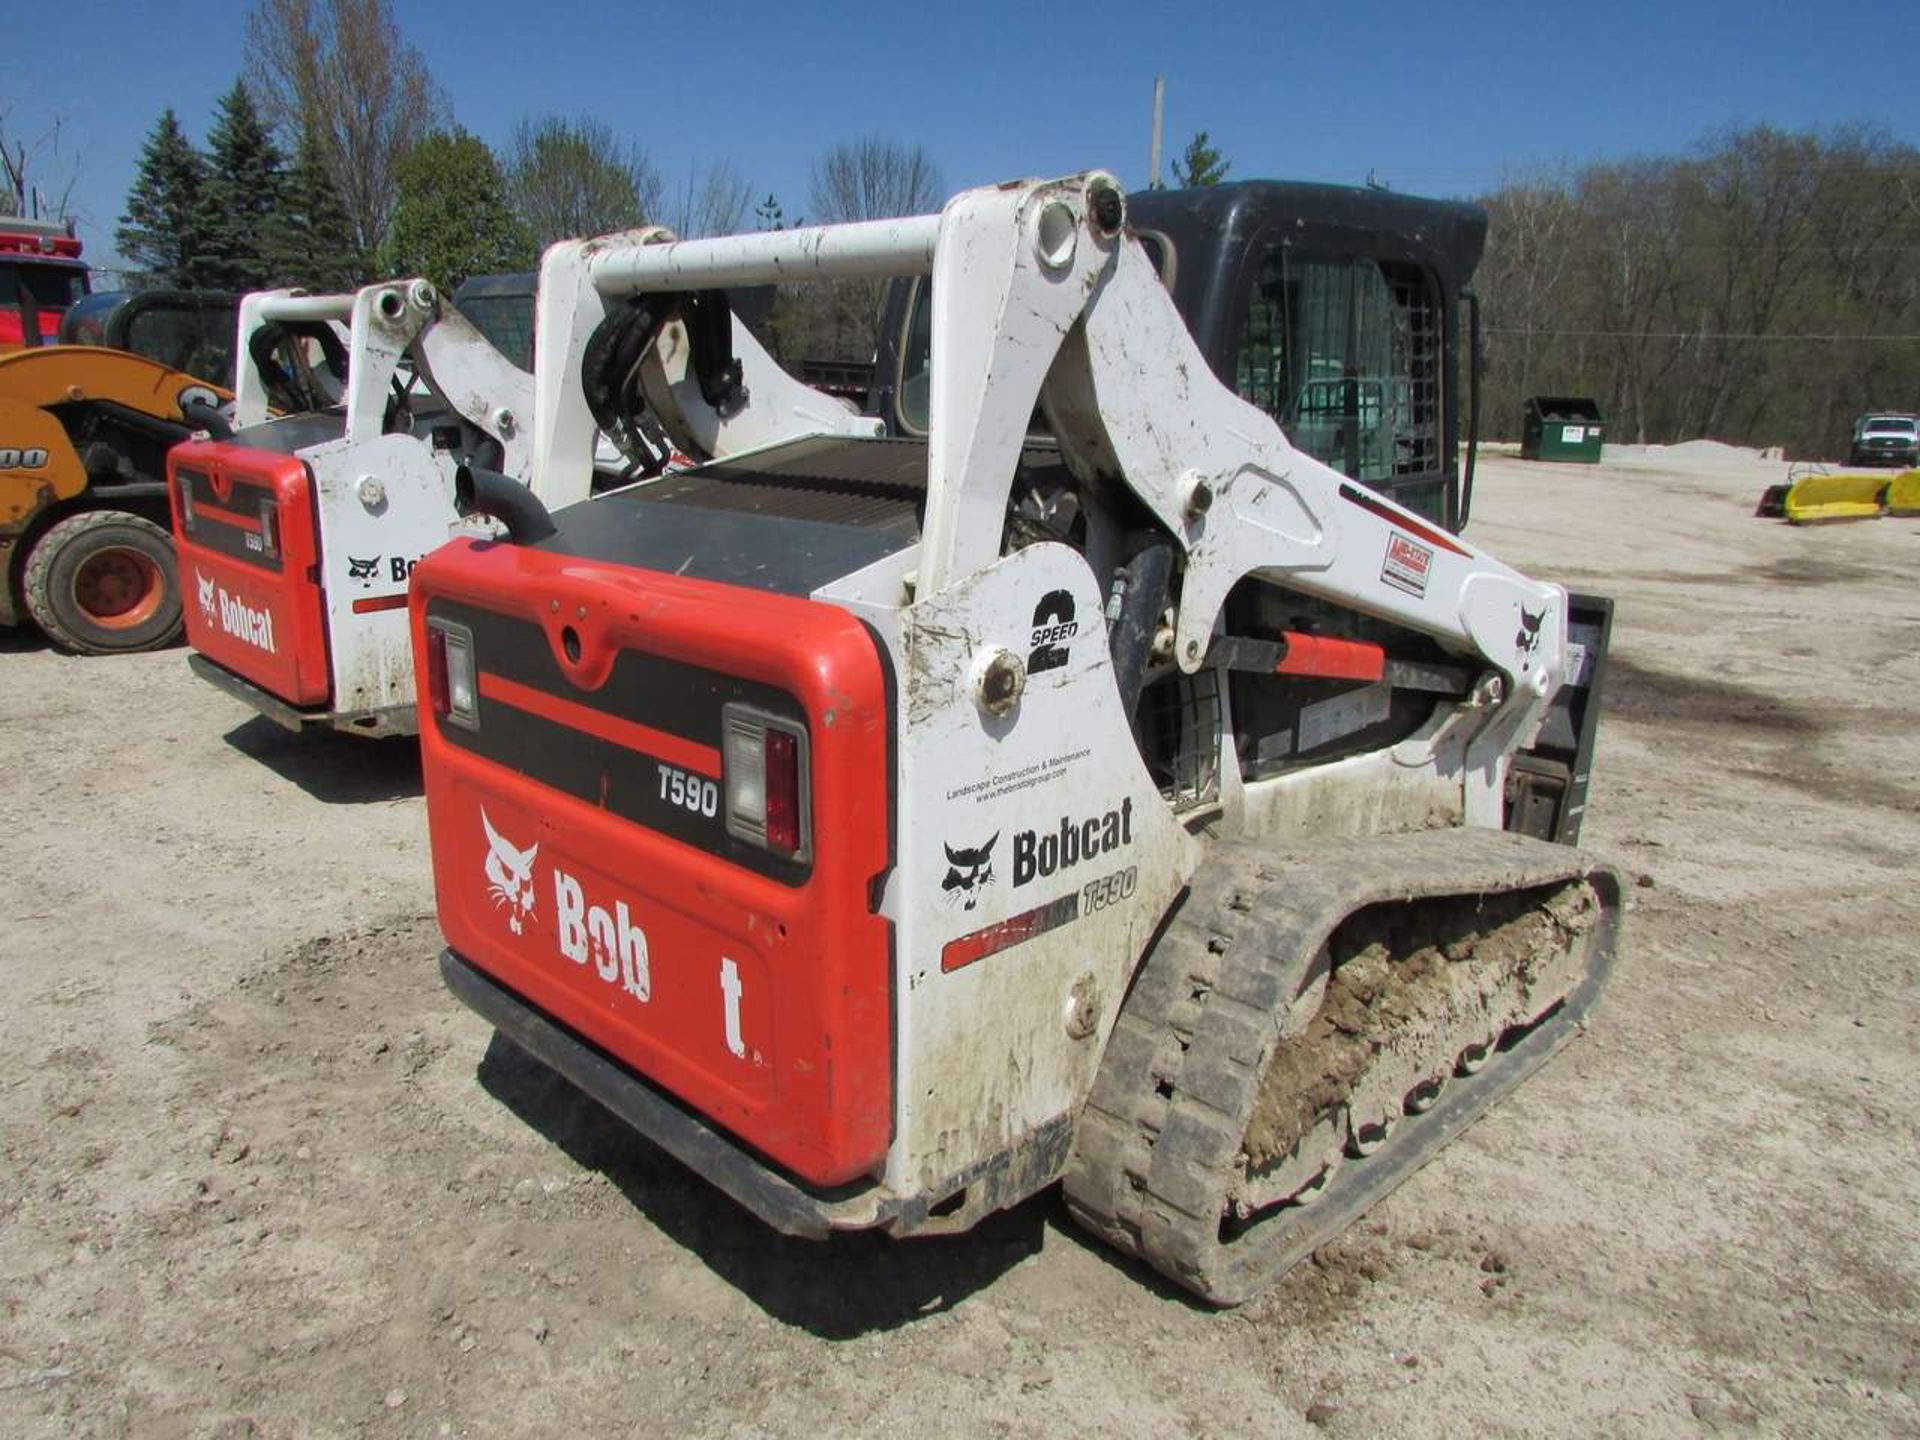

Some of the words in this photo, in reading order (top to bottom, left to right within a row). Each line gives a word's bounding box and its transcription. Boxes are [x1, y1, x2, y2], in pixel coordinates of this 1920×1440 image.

[218, 587, 275, 654] Bobcat
[1030, 622, 1078, 647] SPEED
[657, 765, 718, 818] T590
[946, 779, 990, 800] Landscape
[992, 763, 1039, 786] Construction
[1049, 748, 1091, 767] Maintenance
[1013, 796, 1132, 888] Bobcat
[1084, 865, 1138, 916] T590
